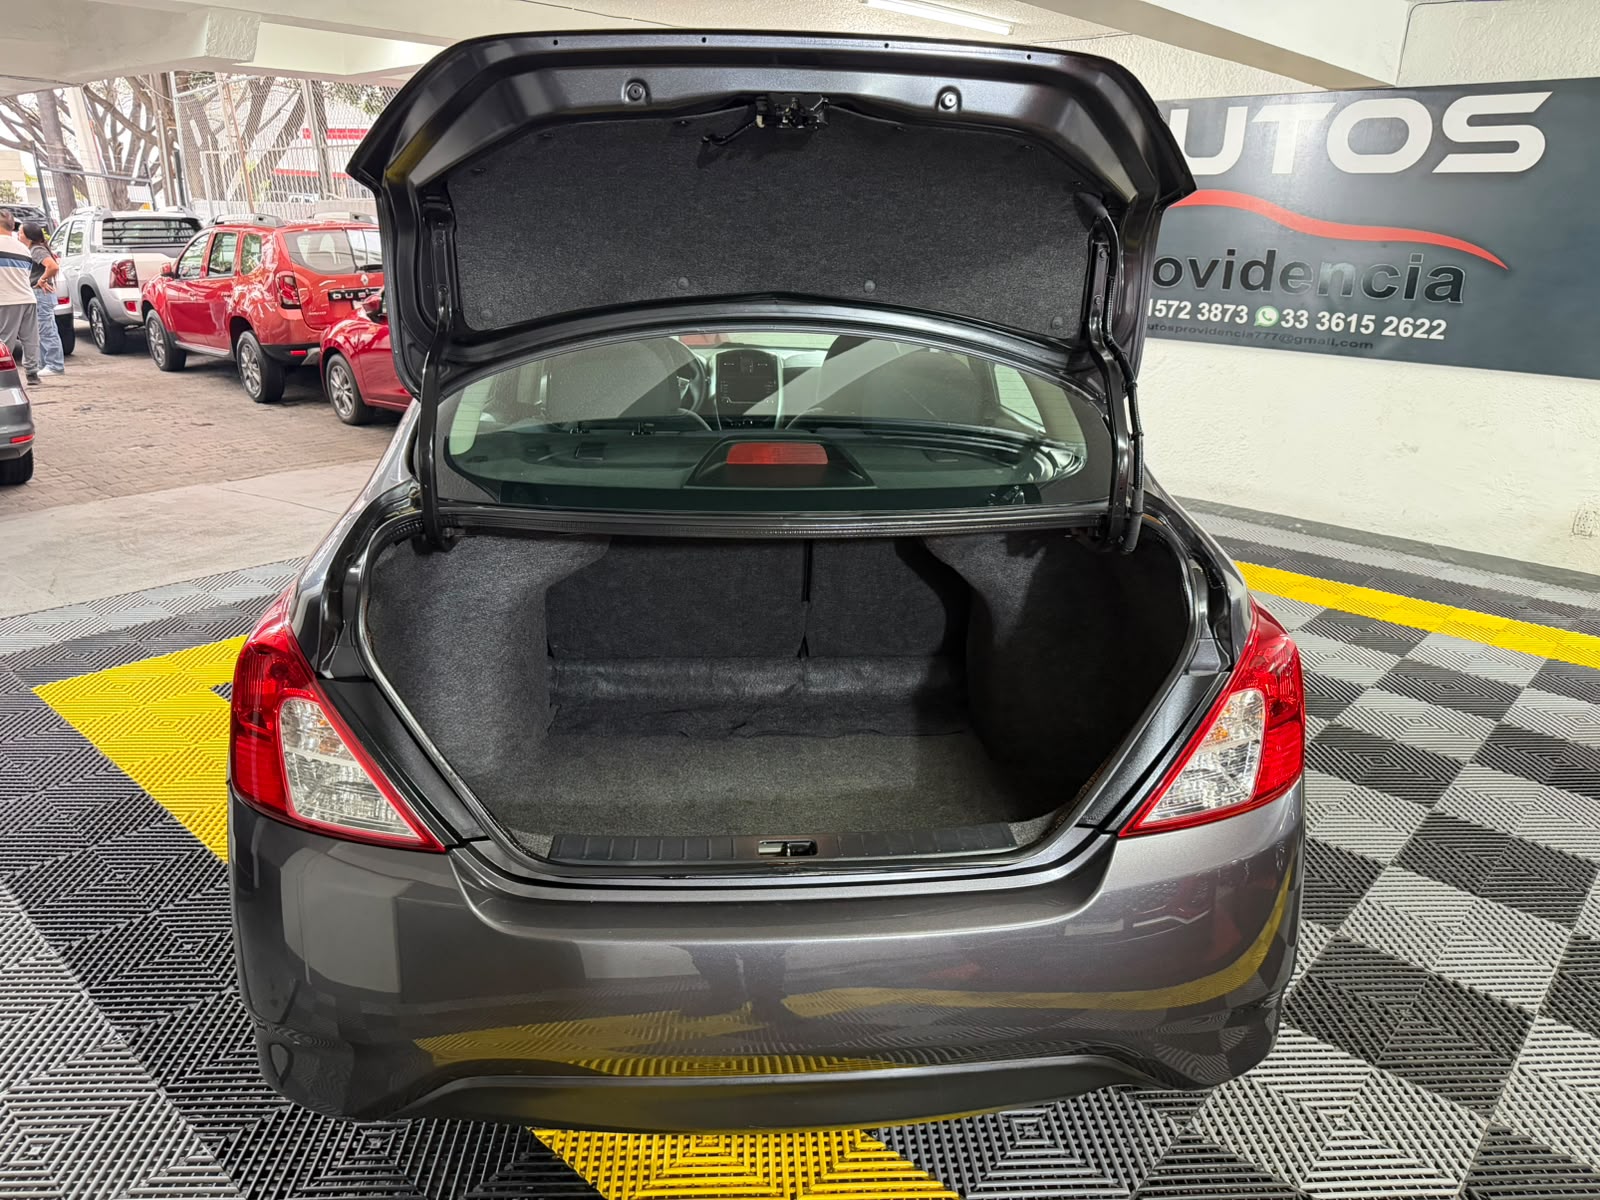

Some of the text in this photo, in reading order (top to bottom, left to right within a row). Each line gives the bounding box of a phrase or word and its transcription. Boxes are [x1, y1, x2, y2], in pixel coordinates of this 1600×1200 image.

[1152, 248, 1467, 304] ovidencia
[1197, 302, 1249, 325] 3873
[1280, 308, 1309, 329] 33
[1315, 311, 1376, 335] 3615
[1381, 315, 1448, 341] 2622
